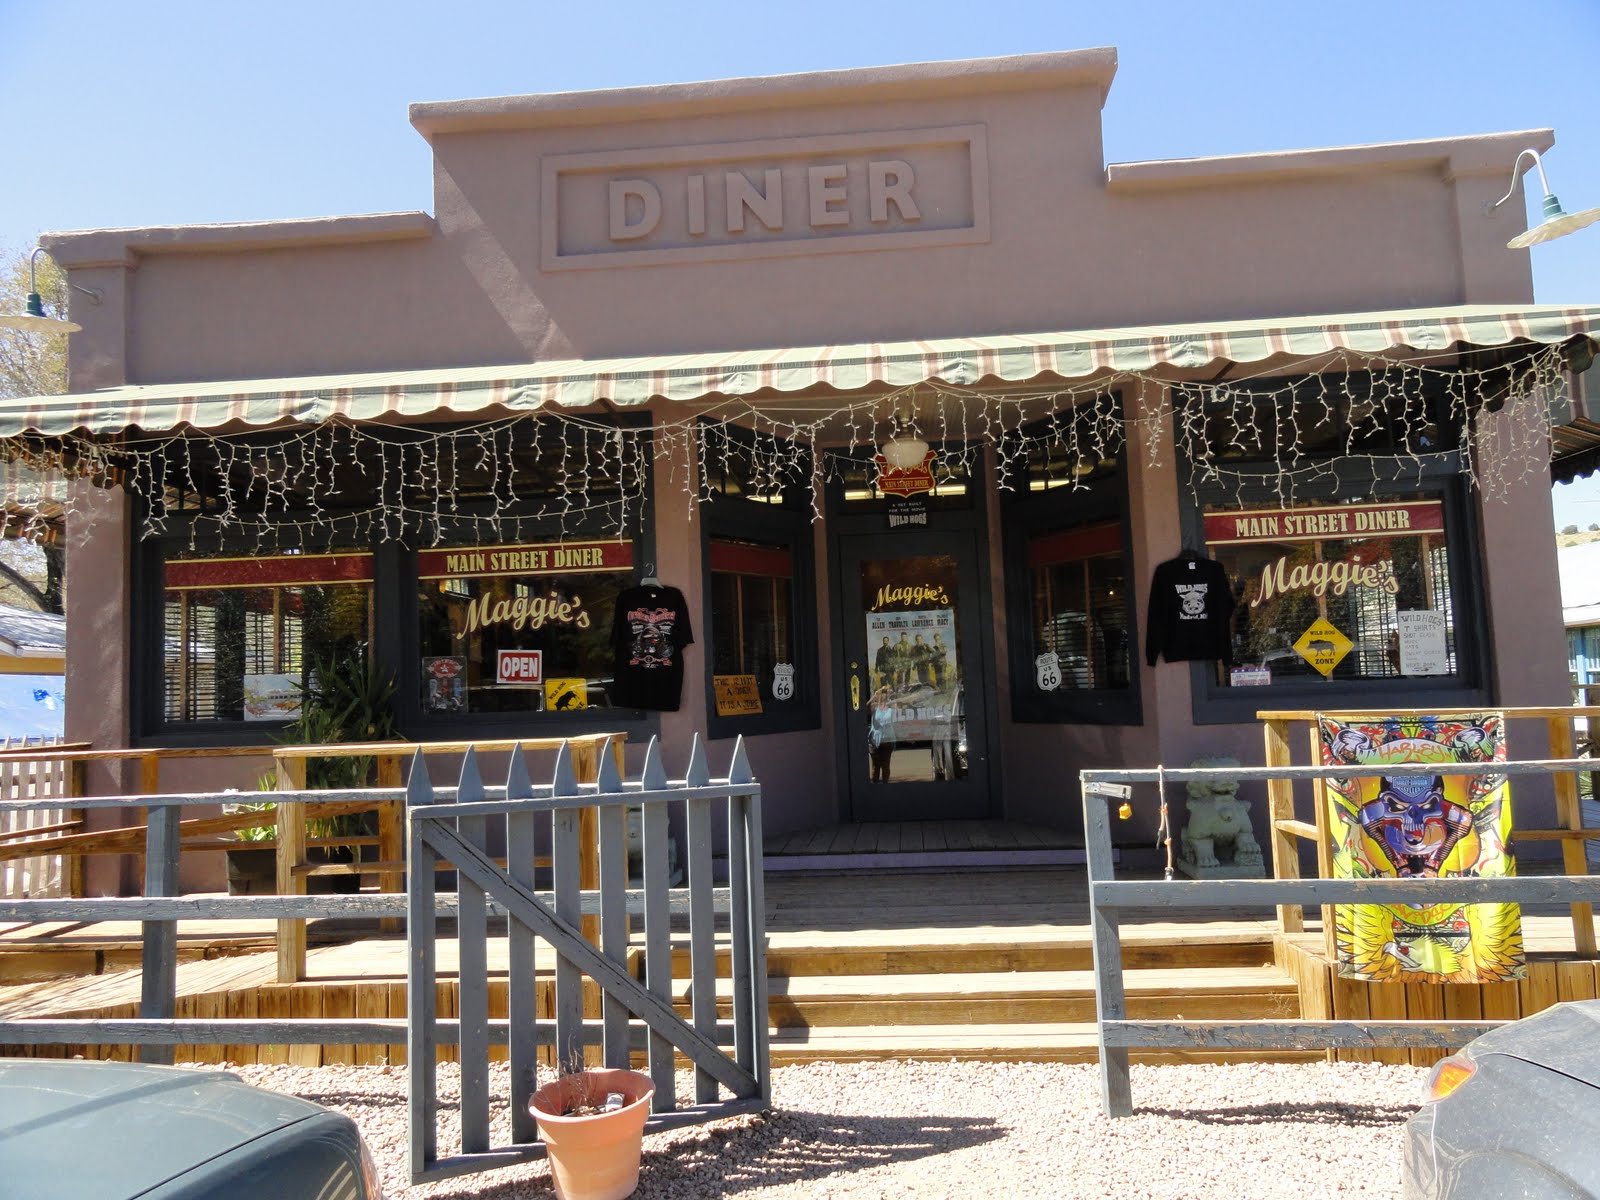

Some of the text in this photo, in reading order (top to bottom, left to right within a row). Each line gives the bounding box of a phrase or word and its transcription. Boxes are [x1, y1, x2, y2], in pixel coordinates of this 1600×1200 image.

[607, 159, 921, 241] DINER
[897, 480, 914, 488] STREET
[914, 479, 929, 487] DINER
[888, 512, 927, 528] WILD HOGS
[1235, 510, 1410, 537] MAIN STREET DINER
[446, 548, 604, 572] MAIN STREET DINER
[1175, 583, 1208, 594] WILD HOGS
[1251, 556, 1399, 608] Maggie's
[871, 583, 949, 611] Maggie's
[456, 591, 590, 640] Maggie's
[1401, 614, 1443, 626] WILD HOGS
[872, 621, 886, 630] ALLEN
[1414, 624, 1437, 632] SHIRTS
[501, 656, 538, 678] OPEN
[1040, 656, 1055, 665] ROUTE
[1042, 672, 1057, 686] 66
[548, 681, 567, 699] WILD HOG
[726, 687, 733, 697] A
[777, 682, 790, 696] 66
[1378, 742, 1446, 763] HARLEY
